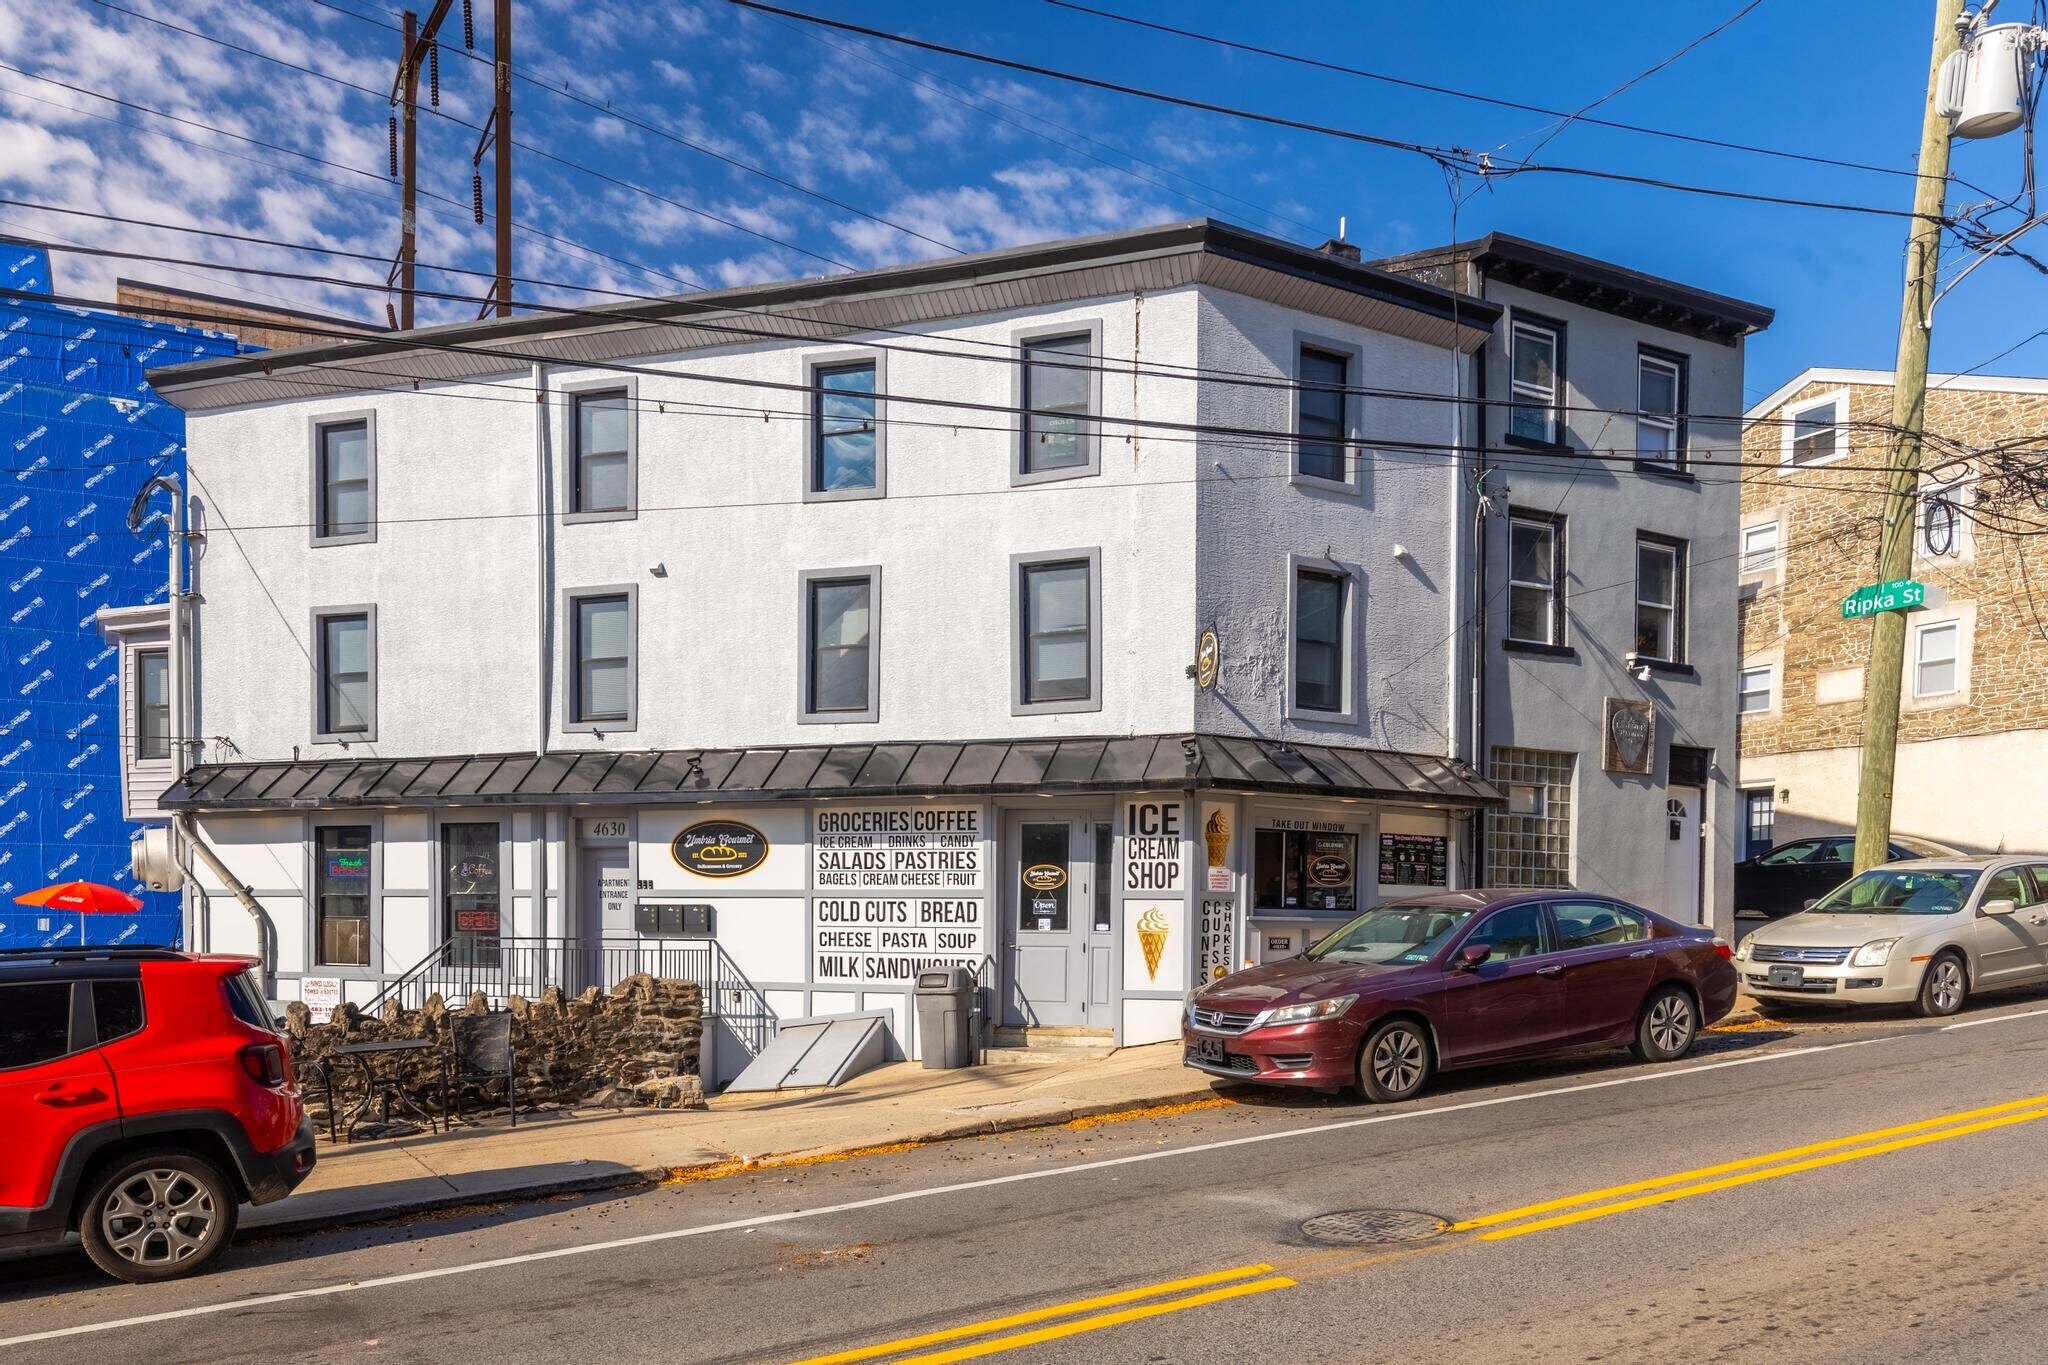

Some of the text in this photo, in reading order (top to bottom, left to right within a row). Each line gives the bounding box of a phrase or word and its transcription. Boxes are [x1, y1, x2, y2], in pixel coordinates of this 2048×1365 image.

[1845, 588, 1921, 615] Ripka St
[593, 822, 626, 836] 4630
[818, 810, 977, 832] GROCERIES COFFEE
[1129, 804, 1180, 836] ICE
[1271, 819, 1345, 832] TAKE OUT WINDOW
[685, 834, 755, 847] Umbria Gourmet
[820, 835, 976, 848] ICE CREAM DRINKS CANDY
[1128, 837, 1180, 860] CREAM
[819, 851, 977, 870] SALADS PASTRIES
[468, 863, 494, 878] Coffee
[819, 873, 977, 886] BAGELS CREAM CHEESE FRUIT
[1128, 862, 1179, 889] SHOP
[599, 891, 629, 899] ENTRANCE
[607, 902, 622, 910] ONLY
[819, 901, 978, 923] COLD CUTS BREAD
[1034, 900, 1055, 910] Open
[819, 932, 977, 949] CHEESE PASTA SOUP
[1212, 900, 1221, 964] CUPS
[1223, 901, 1232, 966] SHAKES
[1200, 900, 1210, 986] CONES
[819, 956, 859, 977] MILK
